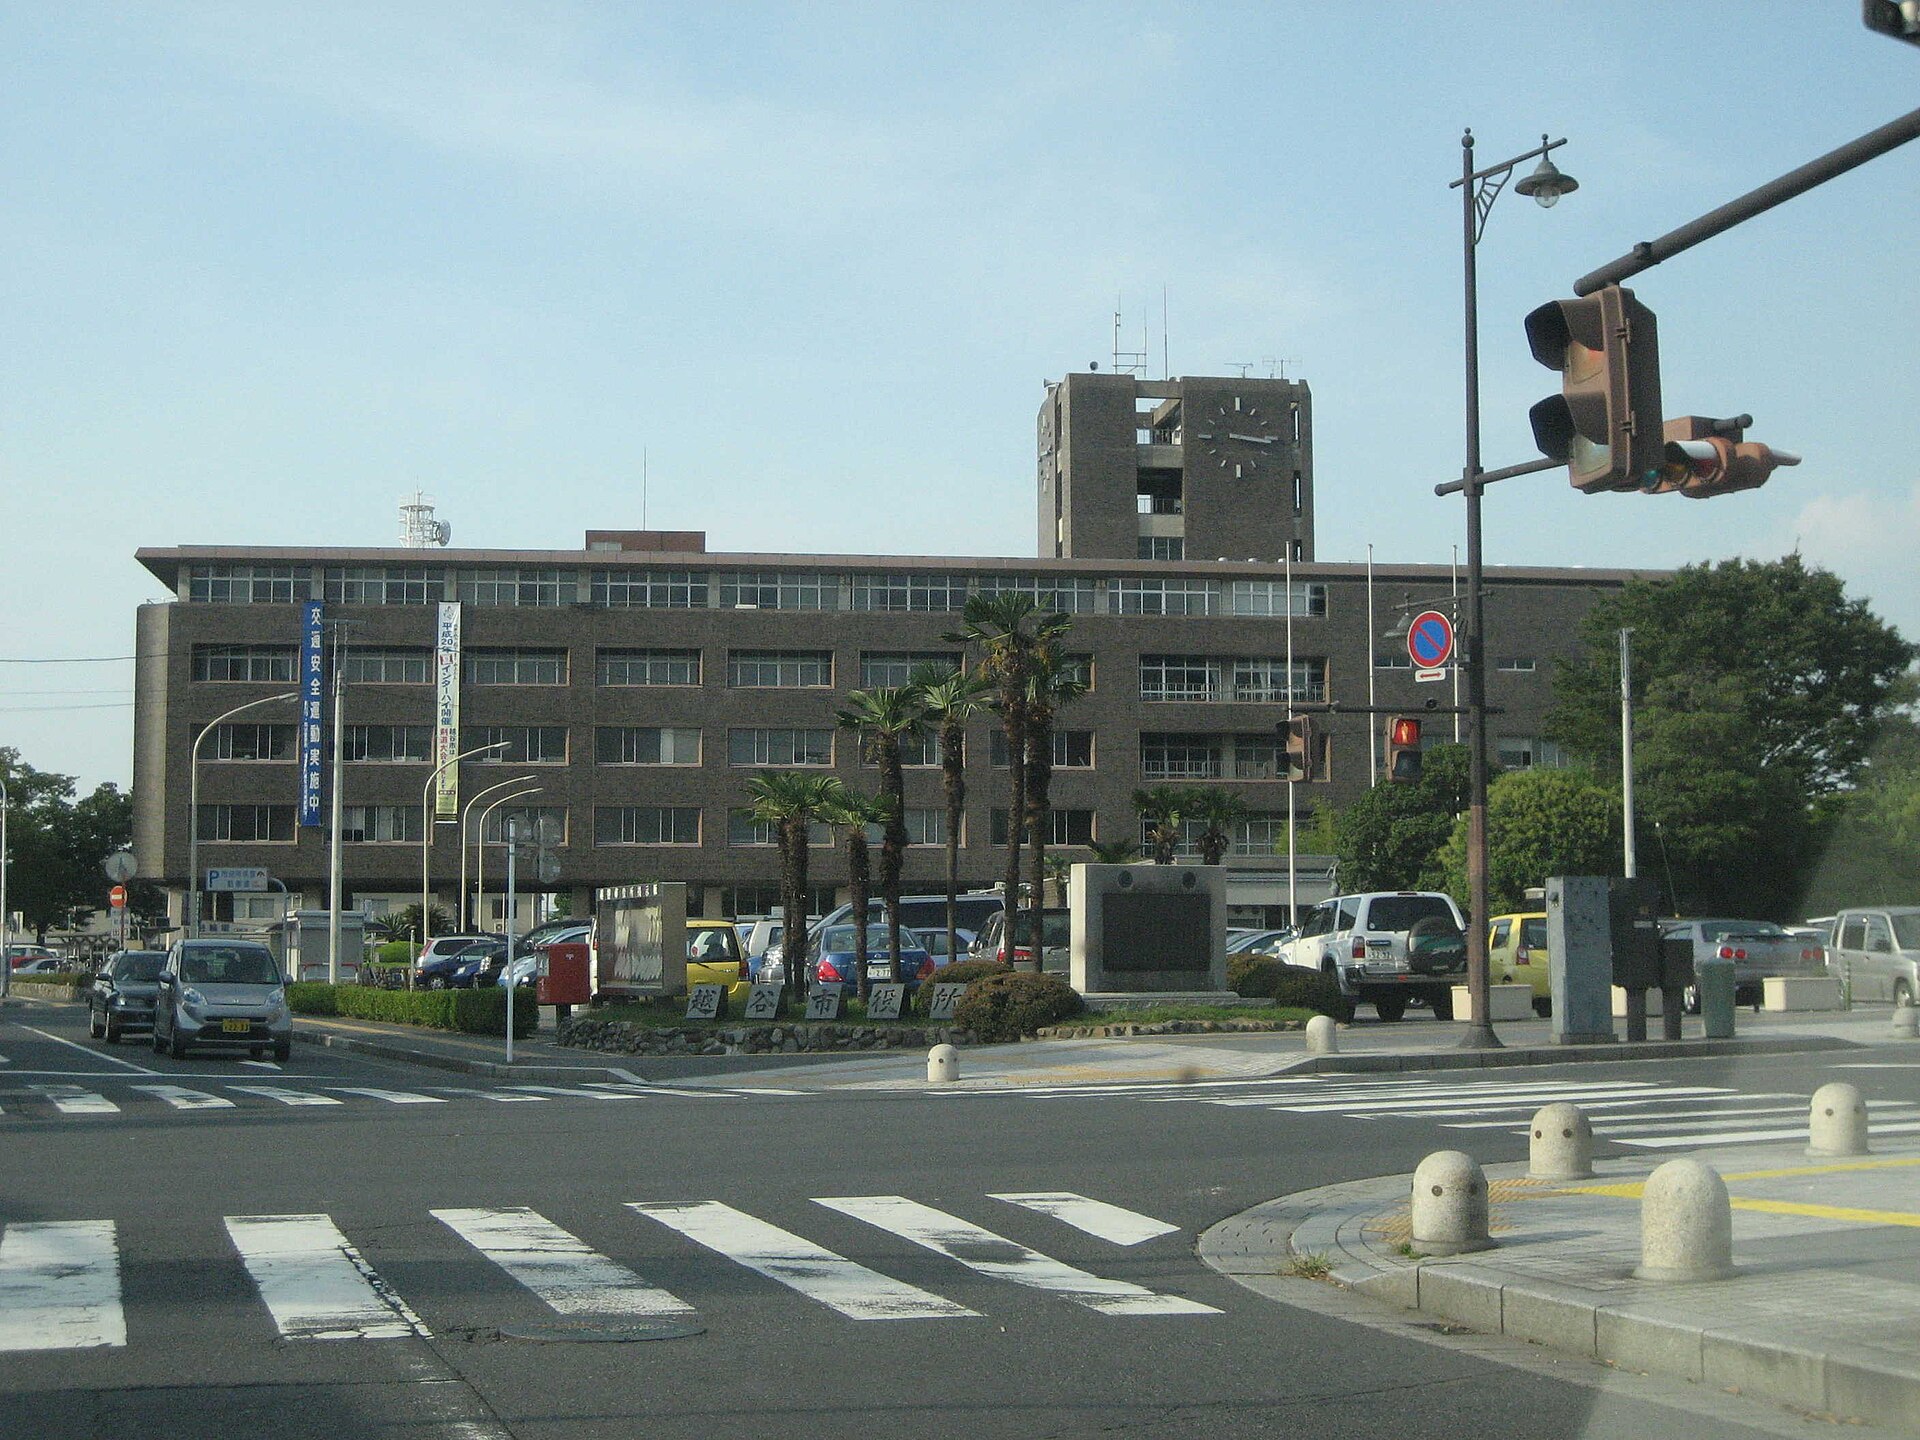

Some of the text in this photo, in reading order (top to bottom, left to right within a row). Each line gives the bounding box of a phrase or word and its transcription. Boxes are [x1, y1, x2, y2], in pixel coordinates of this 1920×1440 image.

[309, 606, 322, 812] 交通安全運動実施中
[209, 869, 220, 888] P
[688, 986, 961, 1016] 越谷市役所
